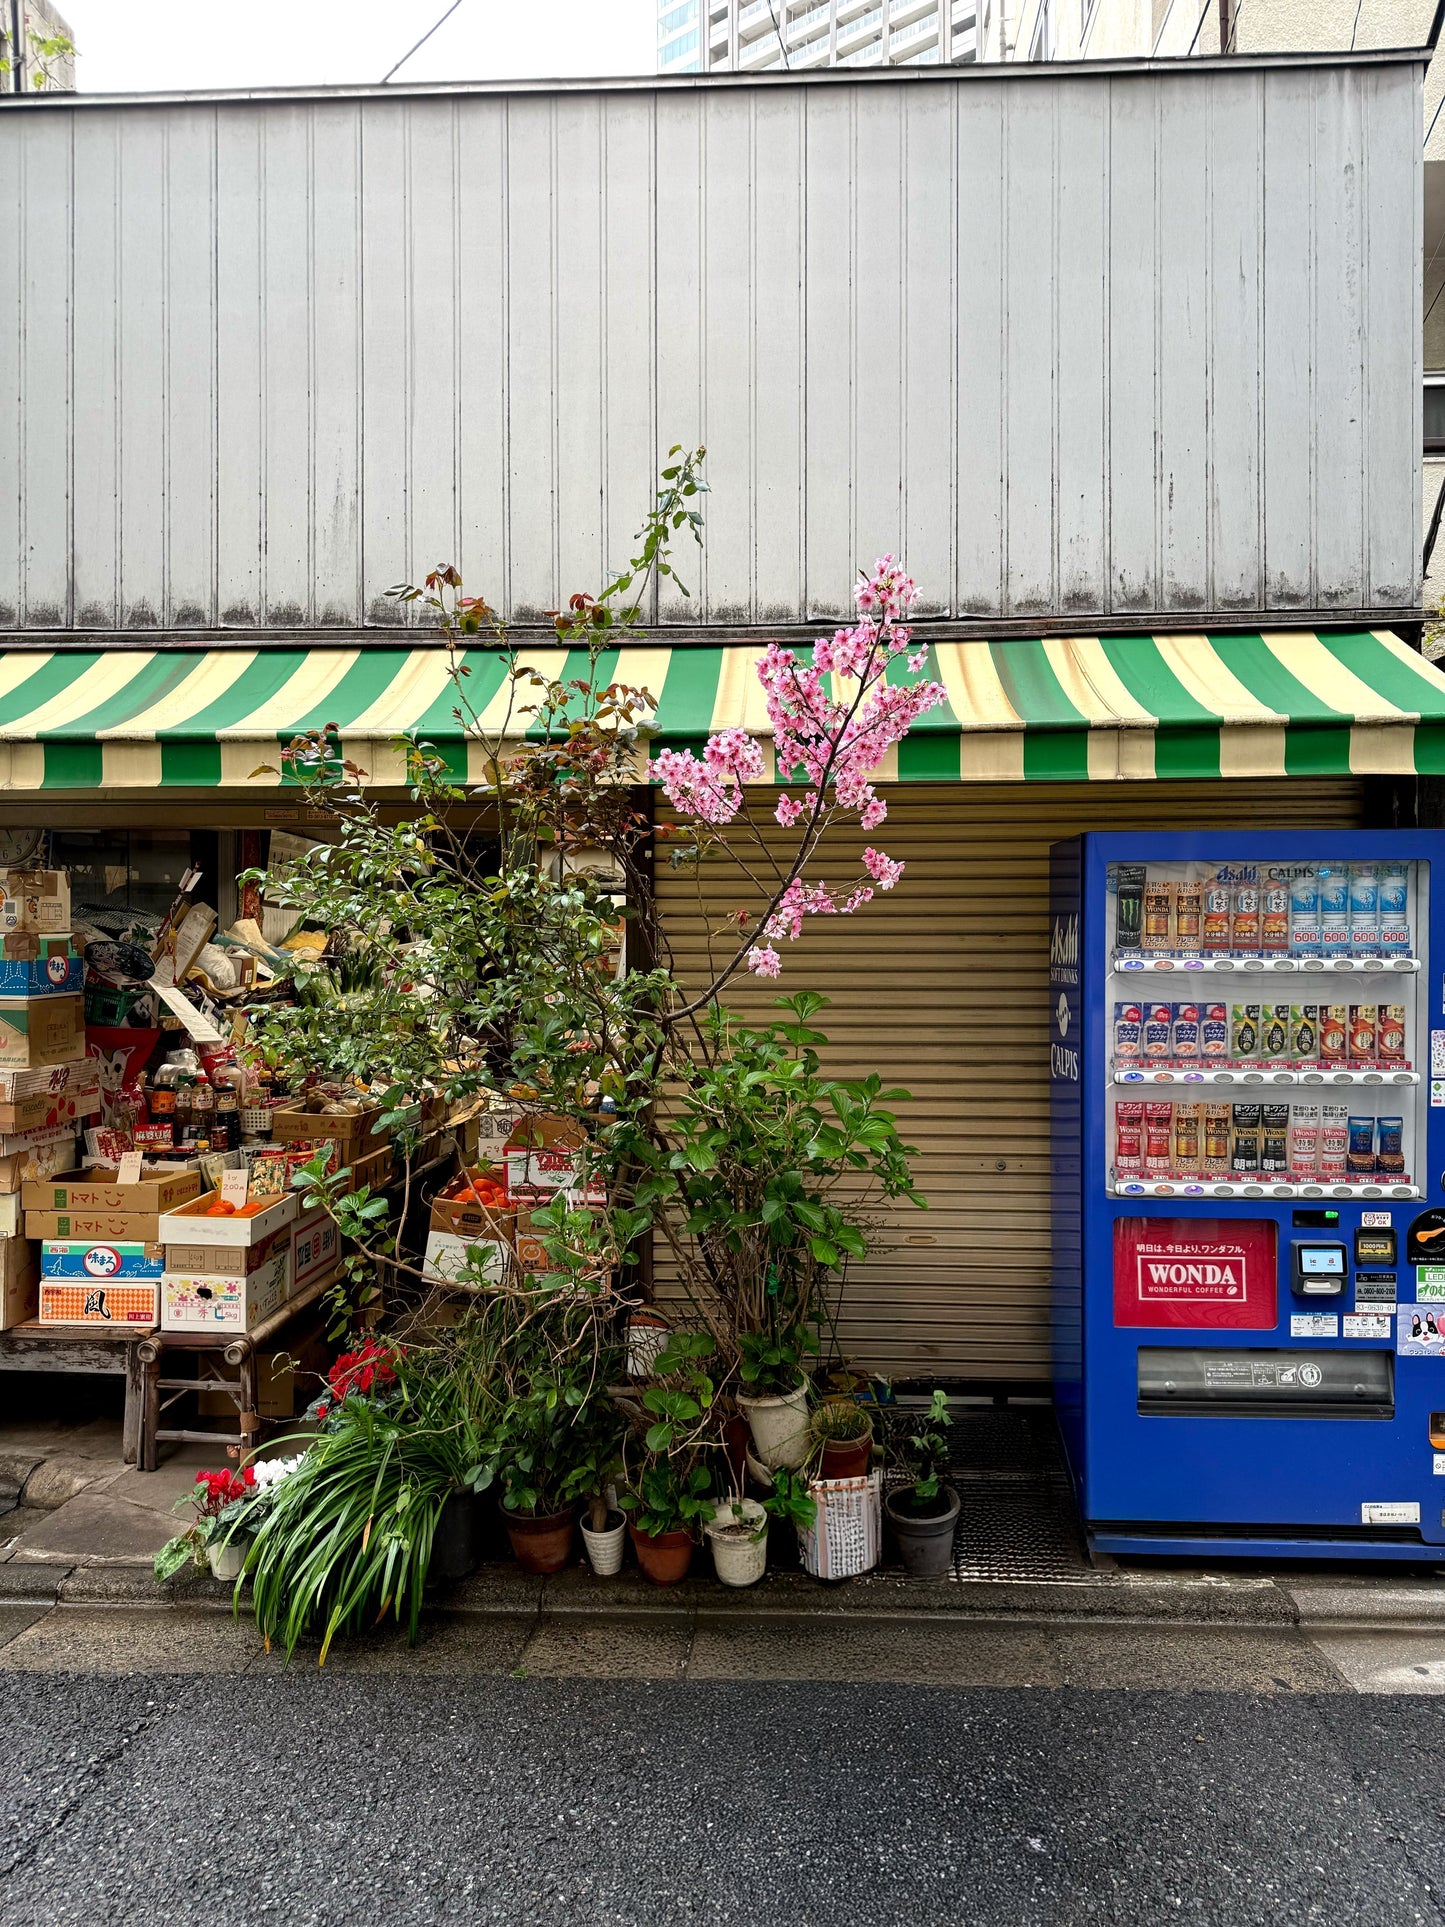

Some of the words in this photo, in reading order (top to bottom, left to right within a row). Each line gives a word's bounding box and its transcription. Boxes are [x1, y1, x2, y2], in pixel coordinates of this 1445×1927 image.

[2, 849, 9, 859] 6
[16, 844, 22, 855] 5
[1216, 865, 1257, 882] Asahi
[1268, 867, 1314, 879] CALPIS
[1146, 905, 1169, 914] WONDA
[1178, 905, 1201, 914] WONDA
[1051, 912, 1078, 965] Asahi
[1051, 1042, 1078, 1082] CALPIS
[1119, 1126, 1141, 1134] WONDA
[1148, 1126, 1170, 1134] WONDA
[1206, 1127, 1229, 1135] WONDA
[1294, 1129, 1317, 1137] WONDA
[1323, 1129, 1347, 1137] WONDA
[135, 1130, 172, 1141] 麻婆豆腐
[71, 1192, 99, 1205] トマト
[75, 1220, 103, 1232] トマト
[1136, 1244, 1246, 1254] 明日は、今日より、ワンダフル。
[87, 1251, 116, 1273] 味まろ
[1148, 1264, 1237, 1285] WONDA
[1195, 1286, 1224, 1294] COFFEE
[84, 1289, 112, 1320] 風
[225, 1311, 238, 1319] 5kg
